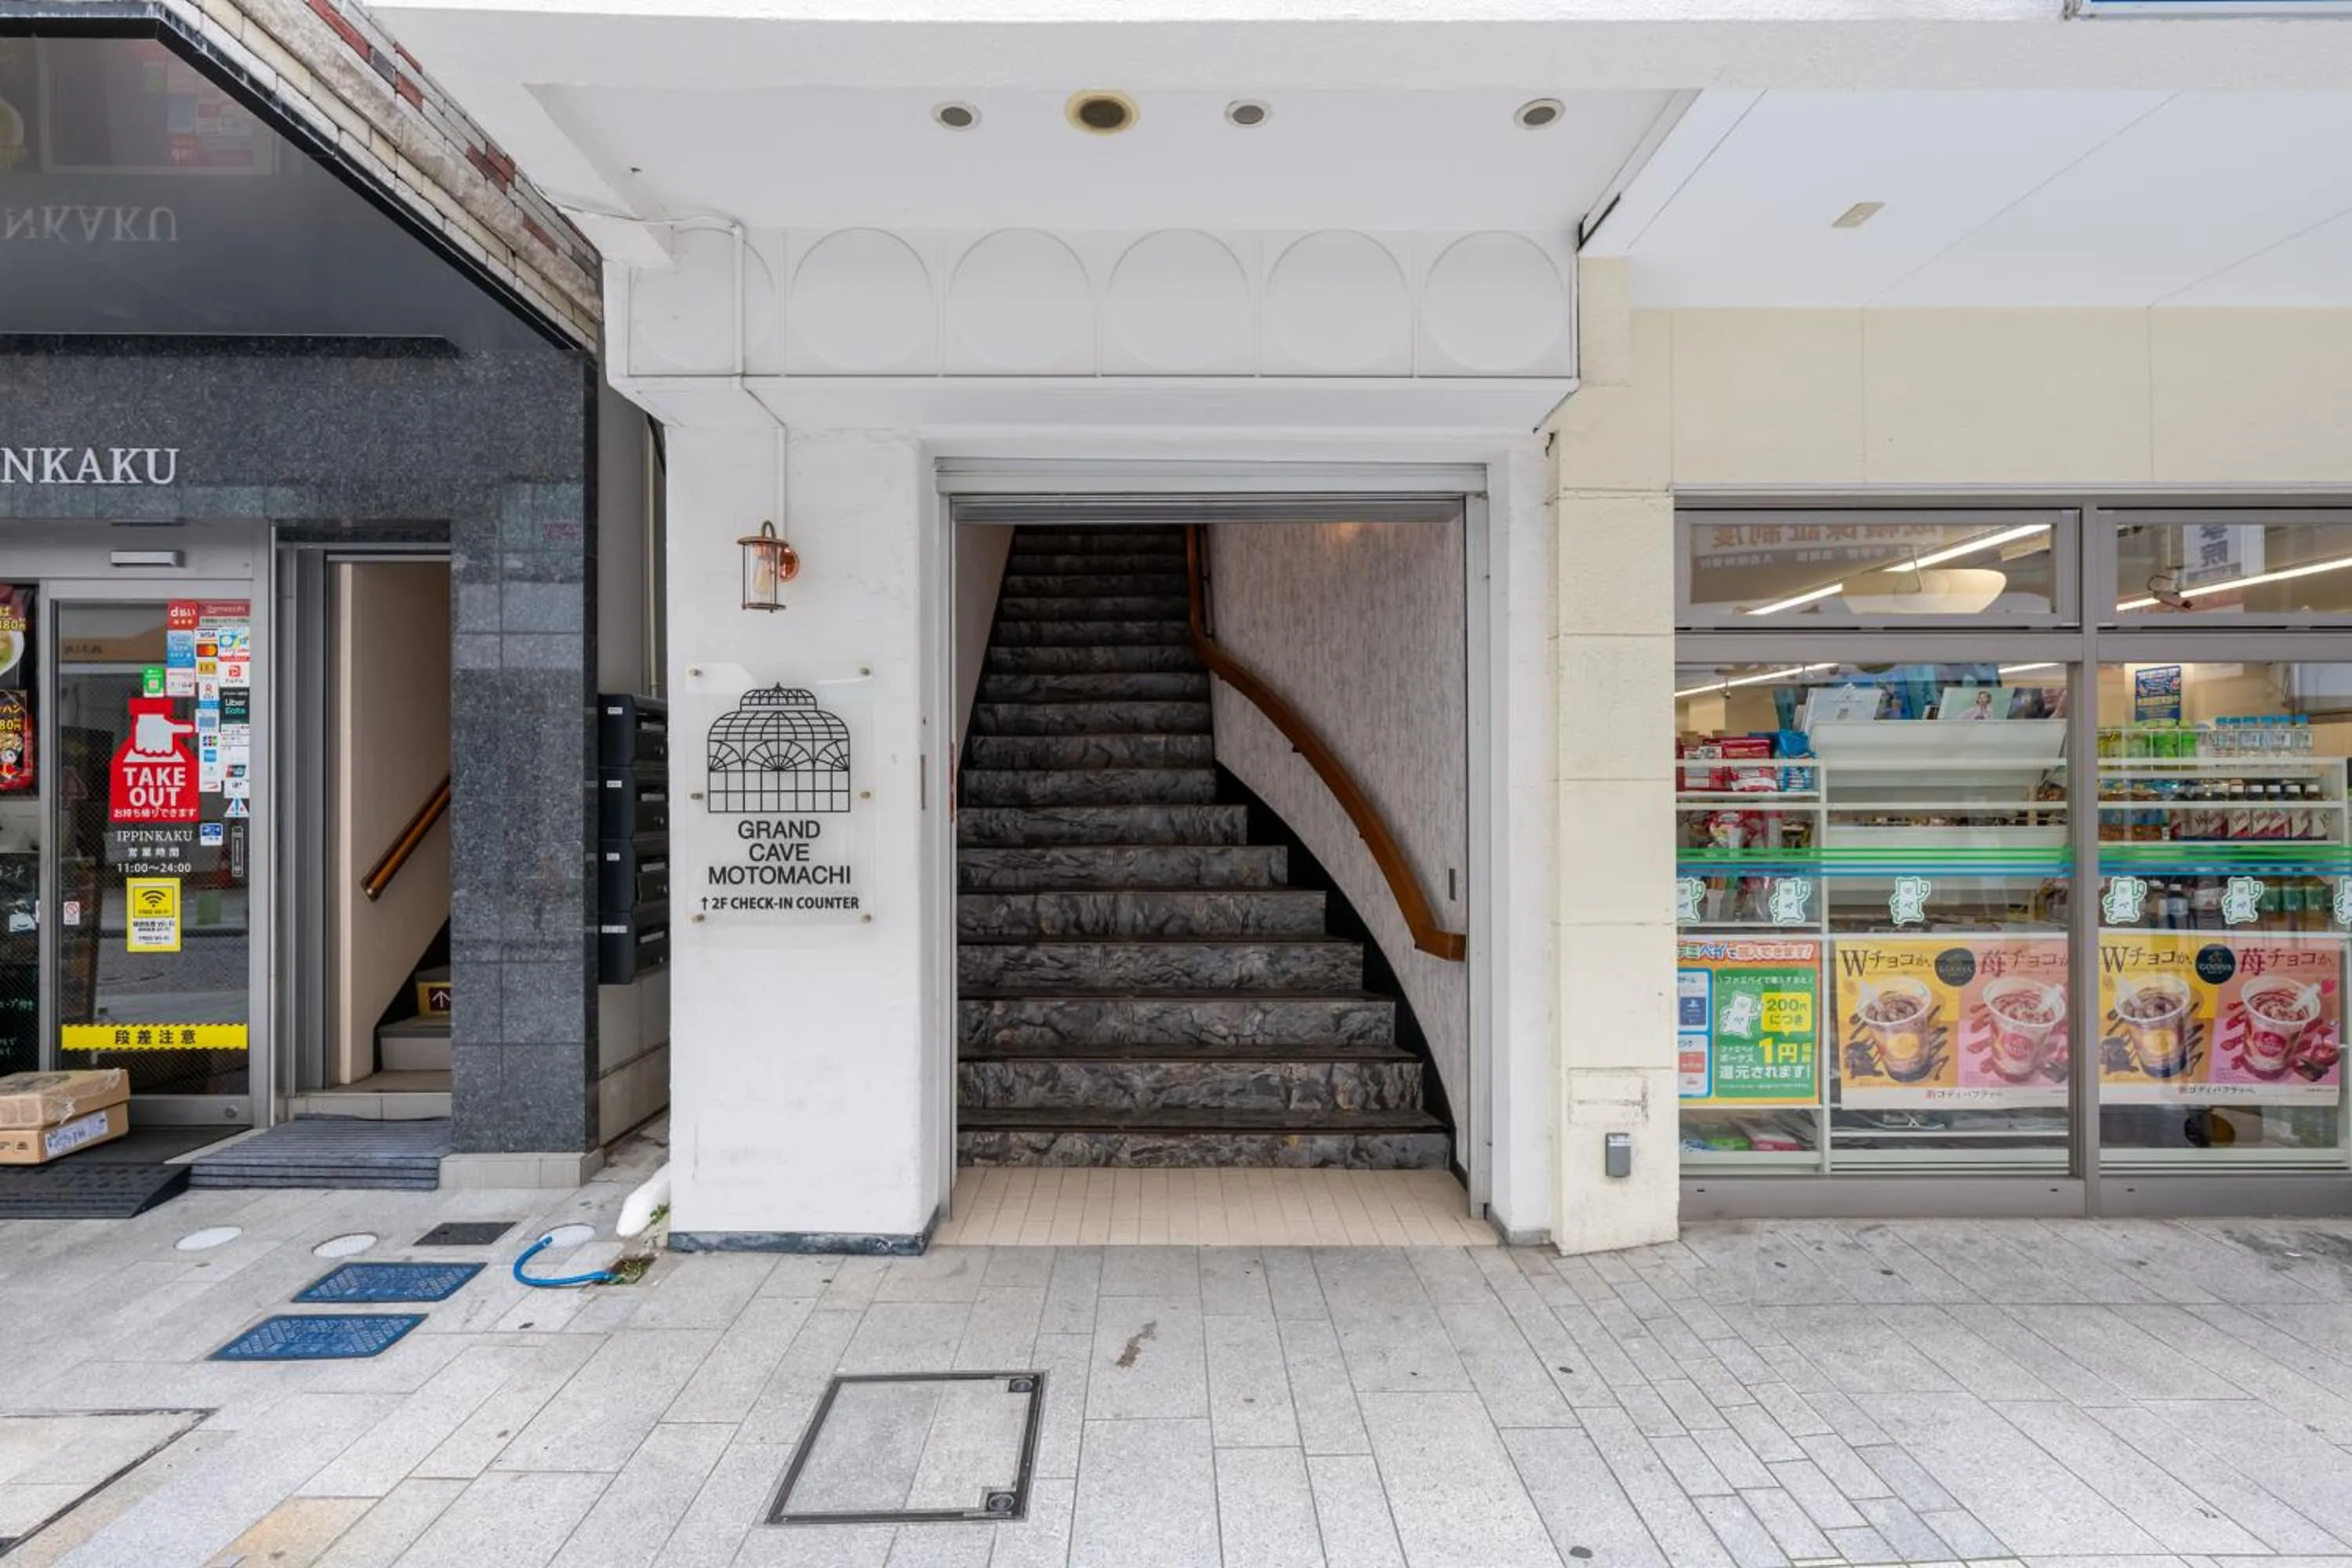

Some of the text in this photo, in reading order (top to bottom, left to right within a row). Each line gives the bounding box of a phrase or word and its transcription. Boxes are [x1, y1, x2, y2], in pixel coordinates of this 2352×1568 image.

[0, 447, 180, 485] NKAKU
[122, 767, 187, 786] TAKE
[129, 787, 181, 807] OUT
[114, 808, 197, 818] お持ち帰りできます
[117, 830, 193, 842] IPPINKAKU
[738, 820, 821, 840] GRAND
[749, 843, 810, 862] CAVE
[708, 865, 851, 885] MOTOMACHI
[711, 896, 860, 910] 2F CHECK-IN COUNTER
[1769, 1014, 1804, 1025] につき
[114, 1029, 196, 1044] 段差注意
